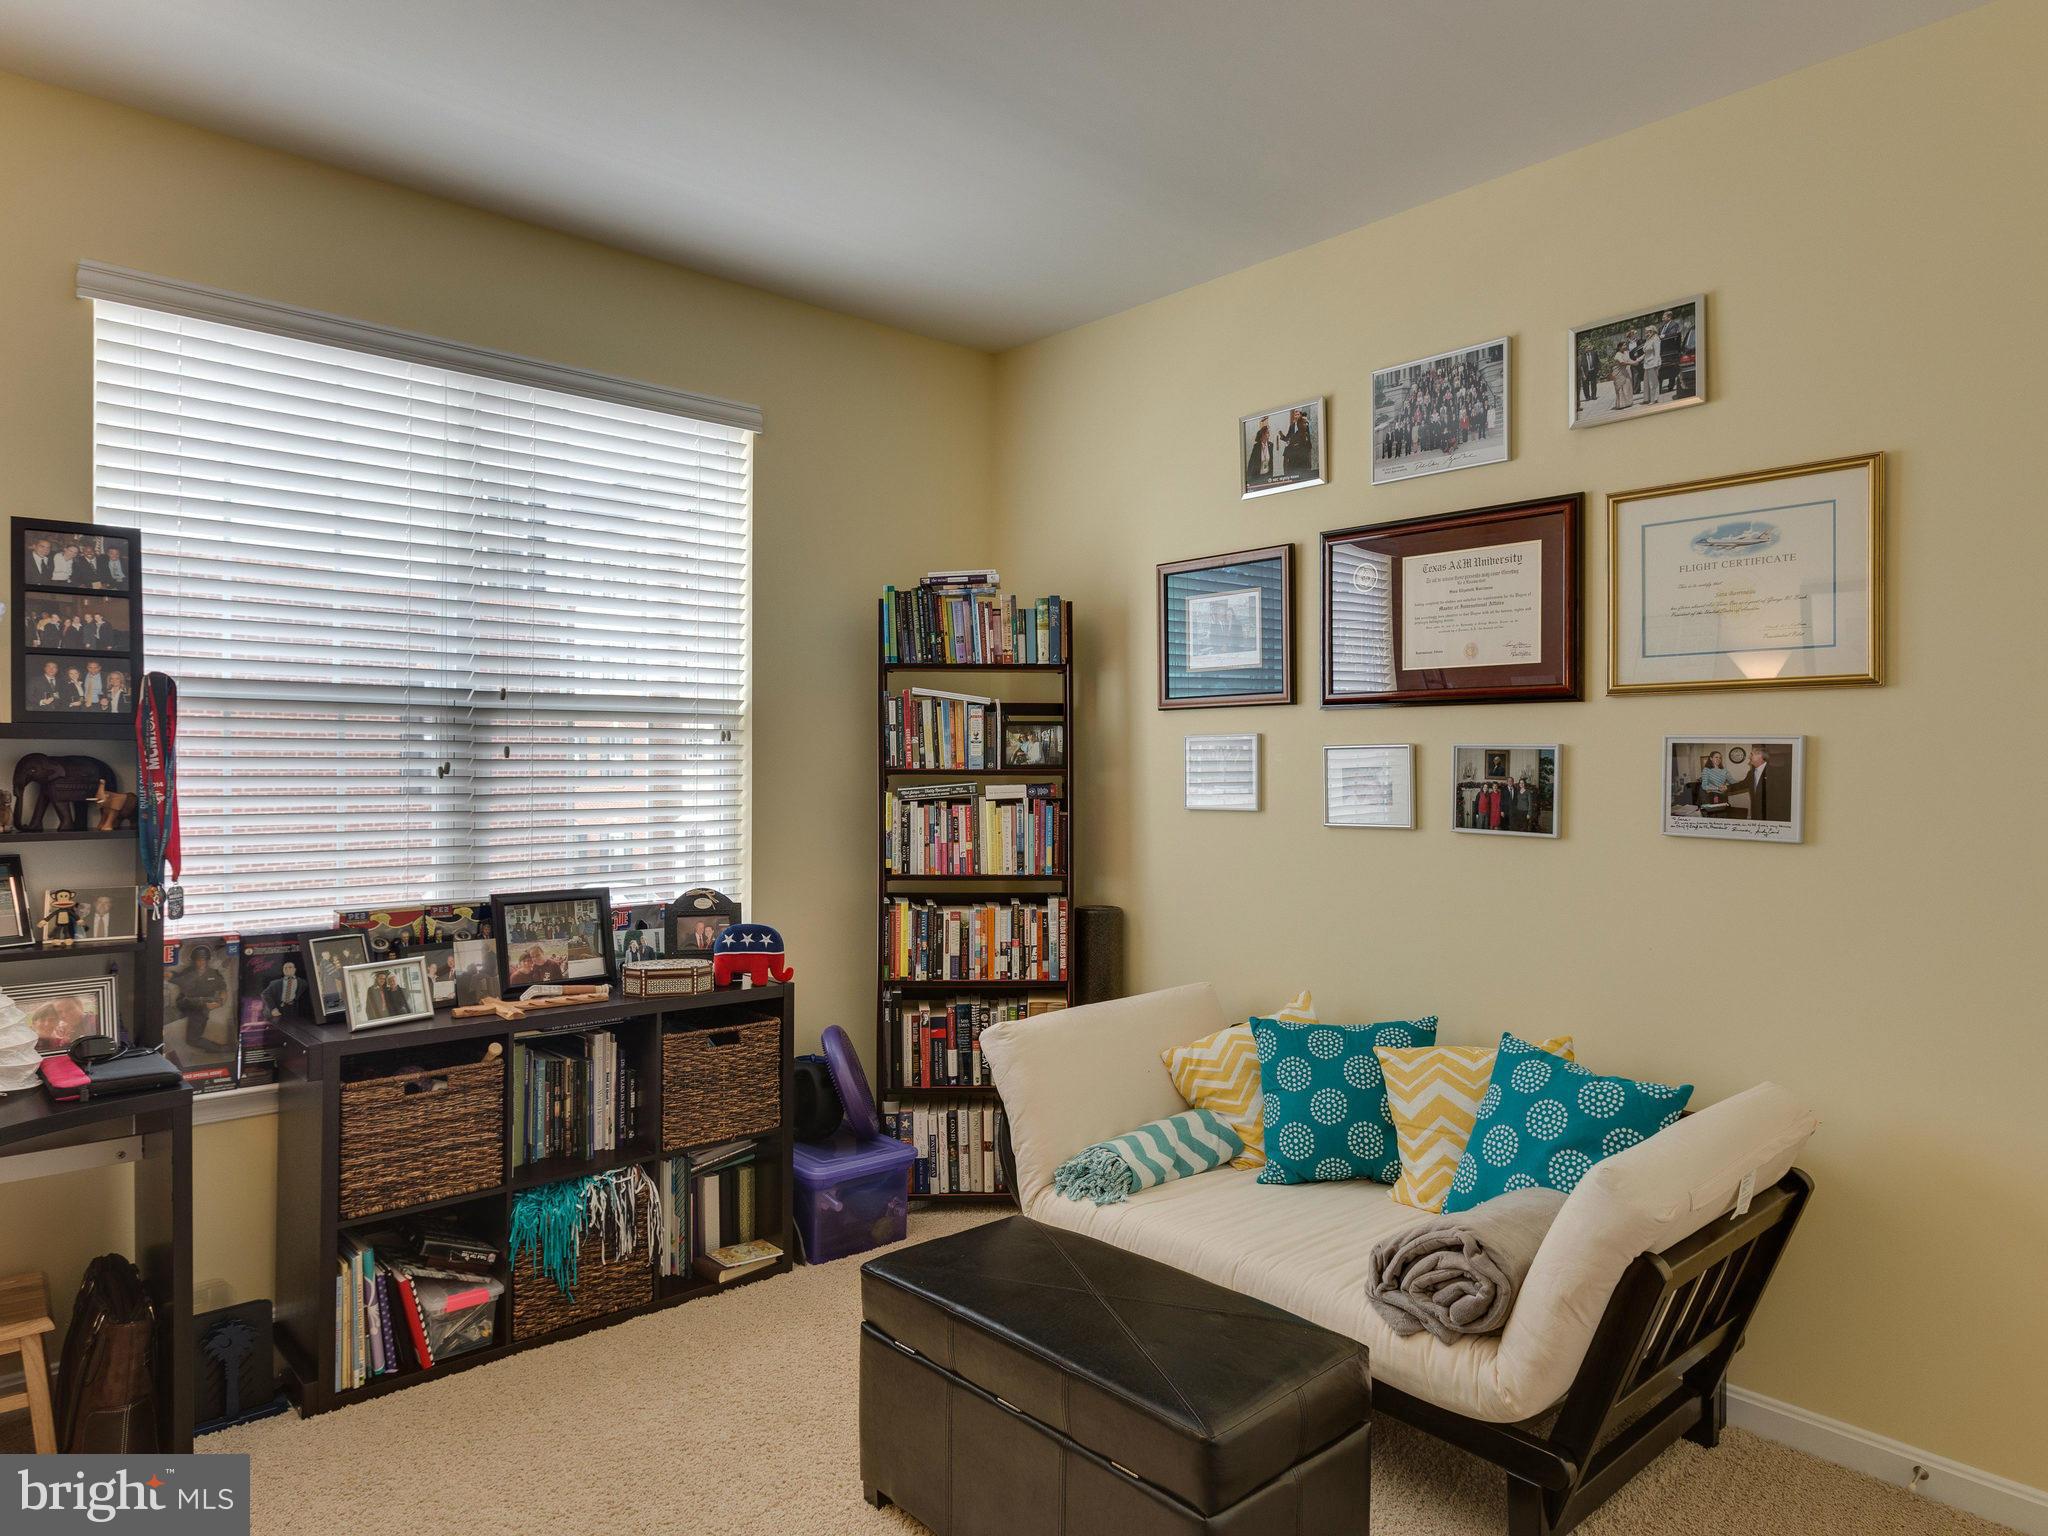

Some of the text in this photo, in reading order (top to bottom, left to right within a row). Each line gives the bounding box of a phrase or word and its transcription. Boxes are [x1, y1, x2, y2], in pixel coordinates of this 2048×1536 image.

[1422, 553, 1523, 574] Texas A&M University
[1679, 553, 1797, 573] FLIGHT CERTIFICATE
[347, 912, 366, 920] PEZ
